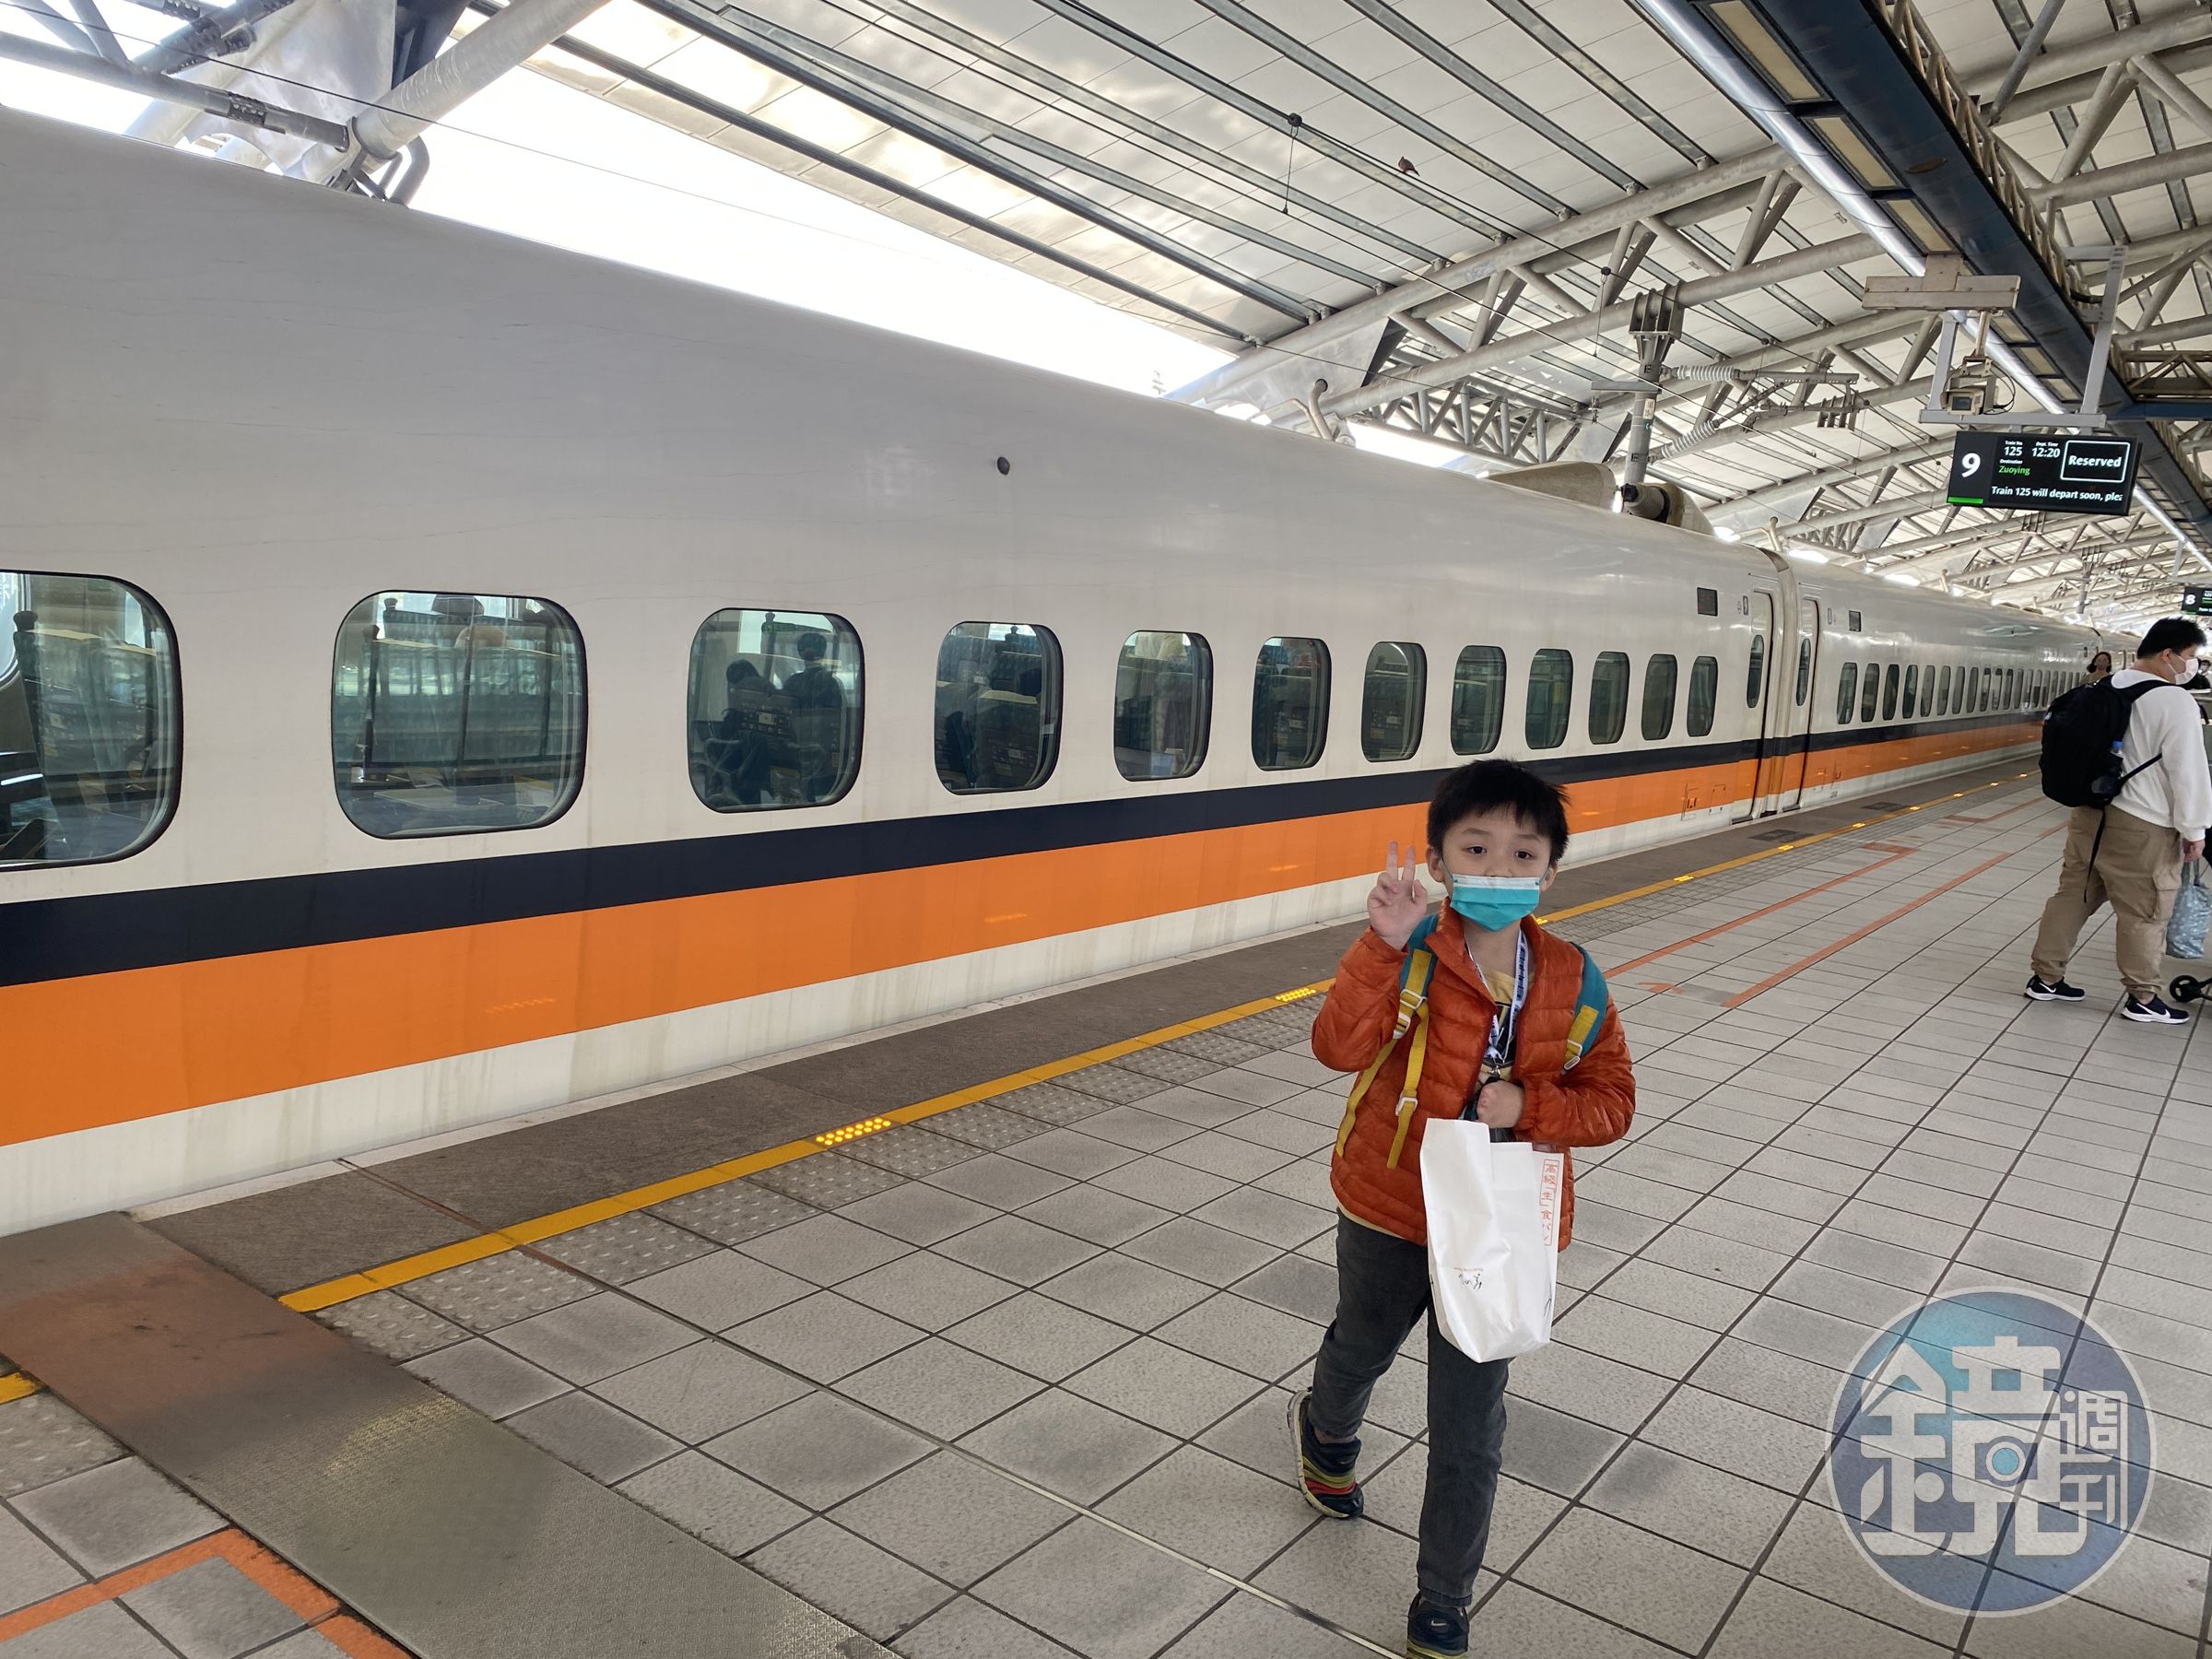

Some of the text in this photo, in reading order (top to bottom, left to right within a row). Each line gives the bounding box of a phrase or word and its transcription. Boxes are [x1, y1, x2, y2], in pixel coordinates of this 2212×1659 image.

[2004, 446, 2023, 456] 125
[2031, 447, 2061, 458] 12:20
[1961, 453, 1982, 478] 9
[2068, 455, 2123, 468] Reserved
[1998, 465, 2030, 476] Zuoying
[1992, 486, 2014, 496] Train
[2016, 488, 2031, 496] 125
[2032, 488, 2048, 498] will
[2049, 488, 2078, 500] depart
[2079, 491, 2103, 501] soon,
[2184, 594, 2196, 605] 8
